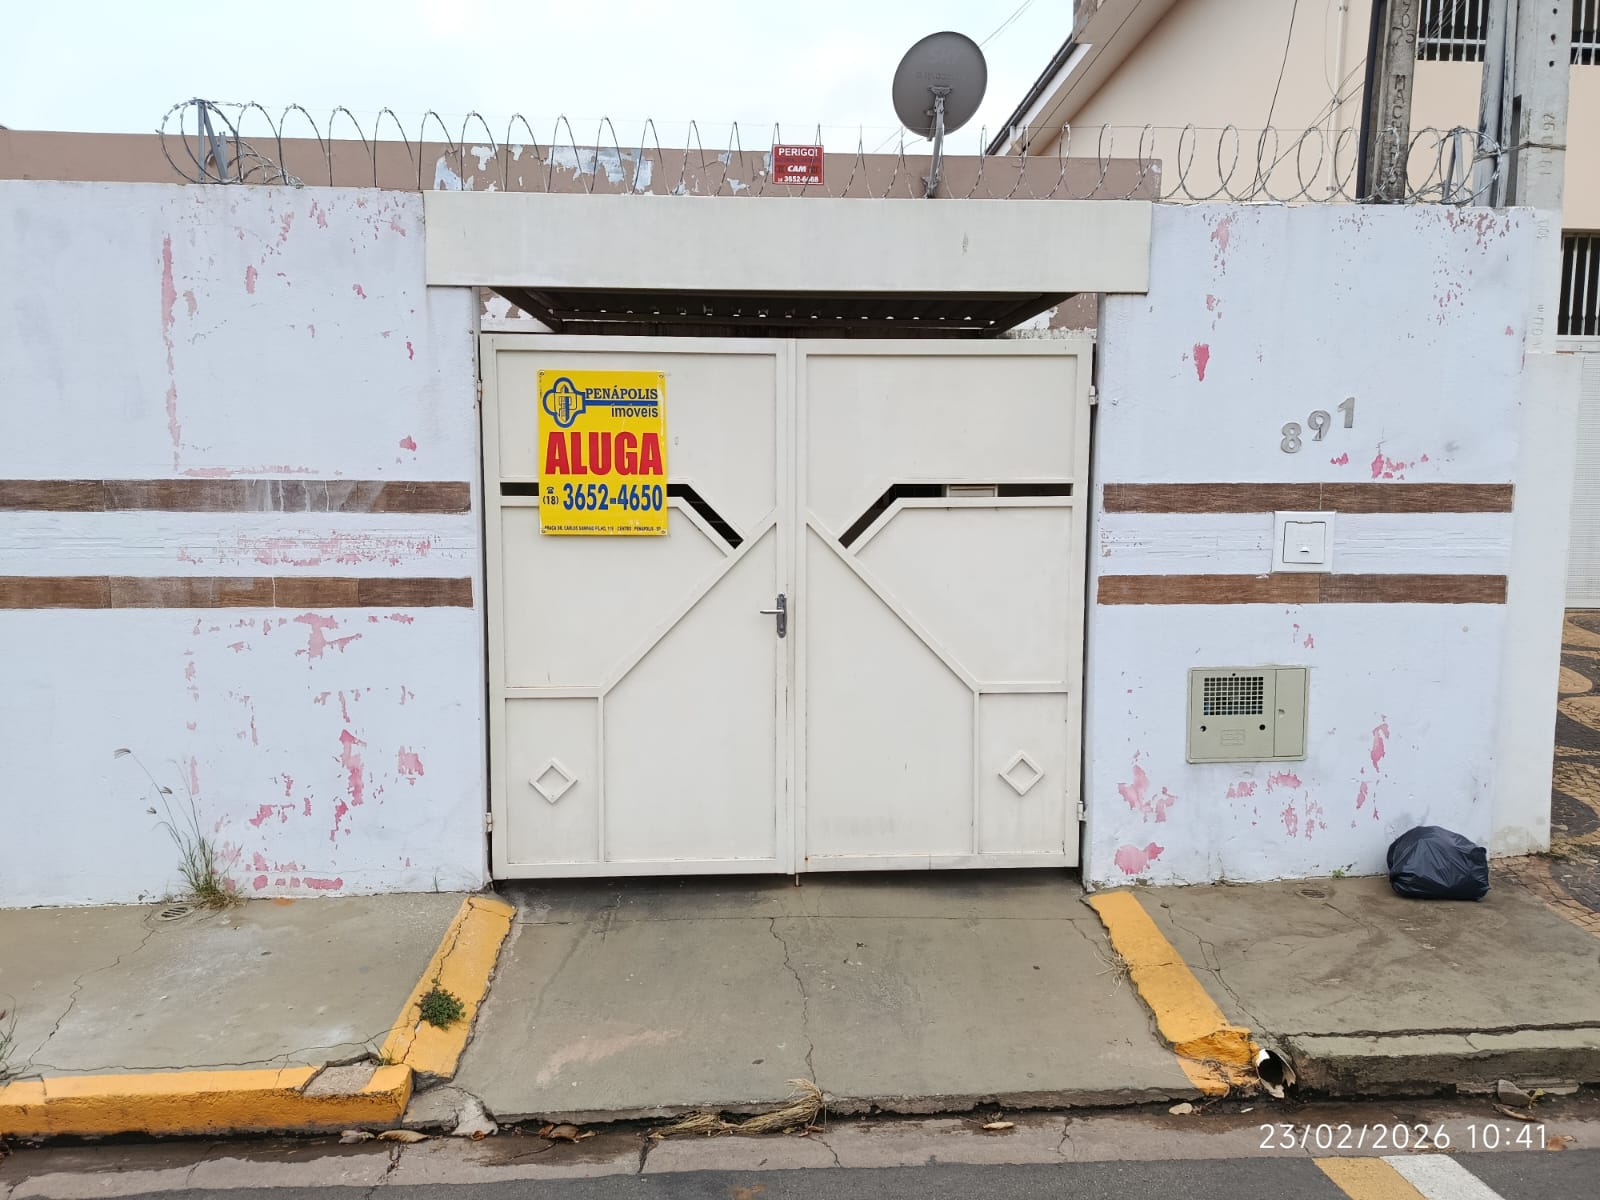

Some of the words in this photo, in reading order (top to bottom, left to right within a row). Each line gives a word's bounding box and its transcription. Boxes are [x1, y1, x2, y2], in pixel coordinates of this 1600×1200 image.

[778, 147, 818, 157] PERIGO!
[787, 165, 807, 173] CAM
[585, 385, 658, 400] PENÁPOLIS
[1279, 396, 1356, 454] 891
[545, 431, 663, 476] ALUGA
[543, 495, 559, 505] (18)
[563, 483, 663, 511] 3652-4650
